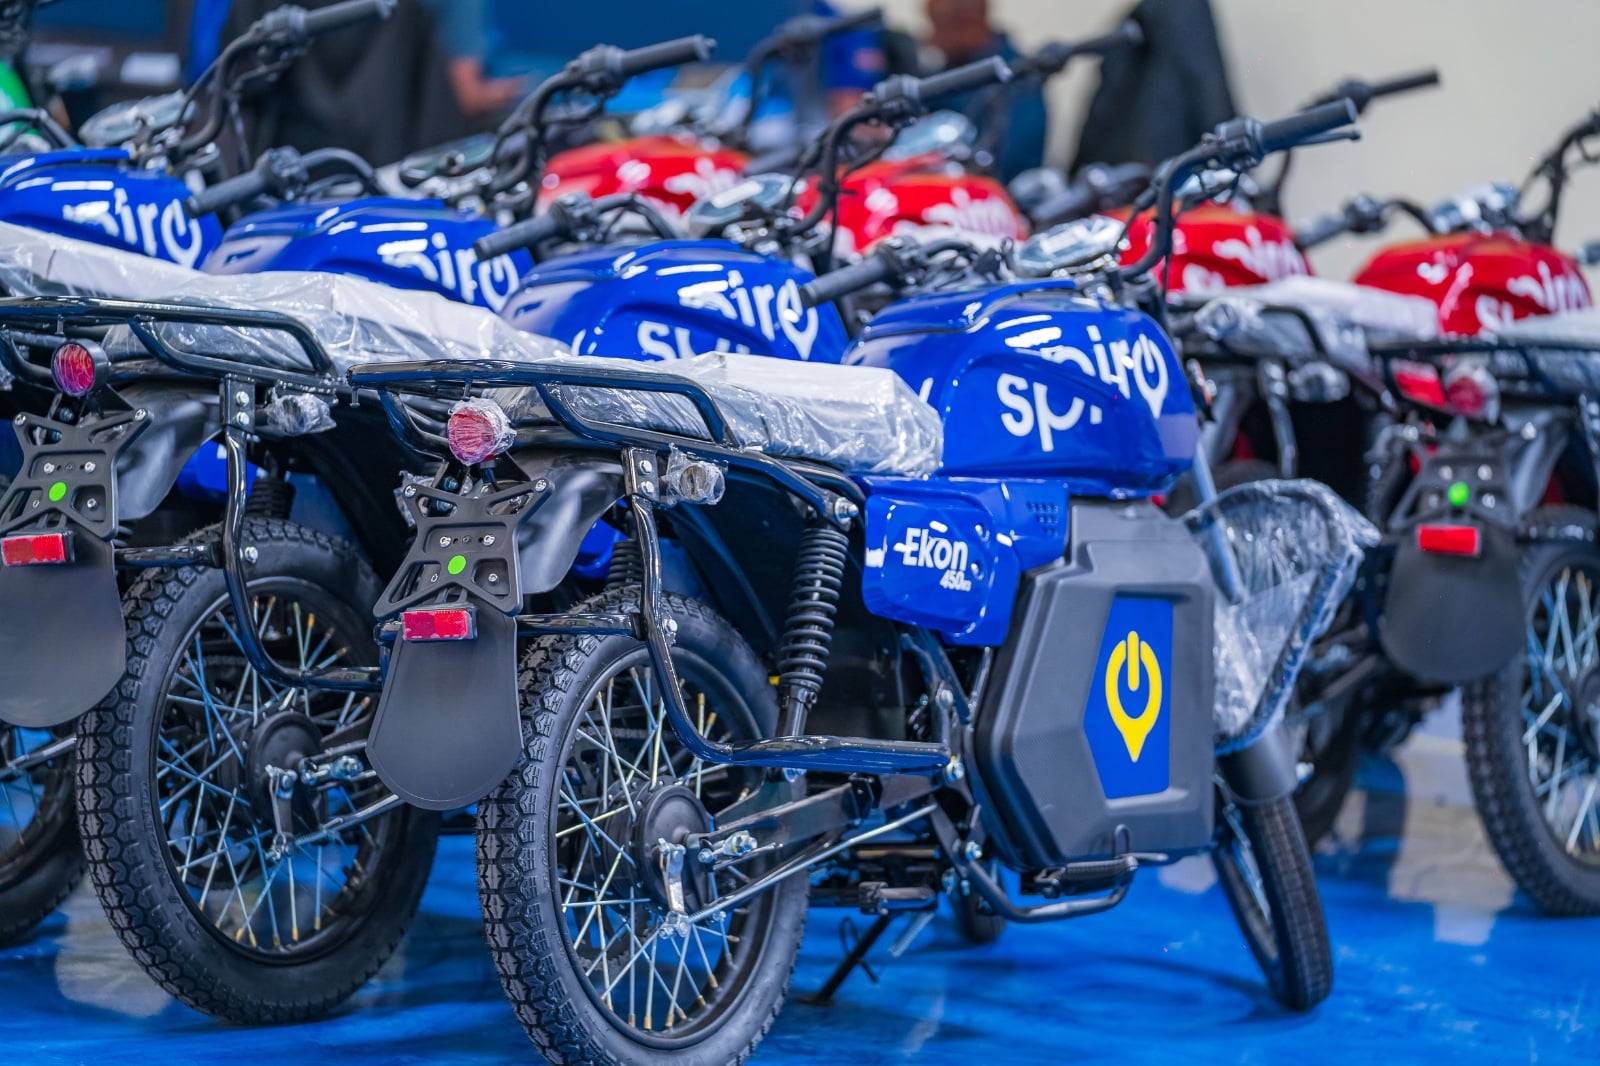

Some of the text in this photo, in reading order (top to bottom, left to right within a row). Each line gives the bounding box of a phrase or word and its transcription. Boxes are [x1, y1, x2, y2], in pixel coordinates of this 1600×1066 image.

[63, 188, 202, 269] iro
[379, 232, 520, 314] iro
[997, 325, 1168, 452] spiro
[903, 528, 968, 572] Ekon
